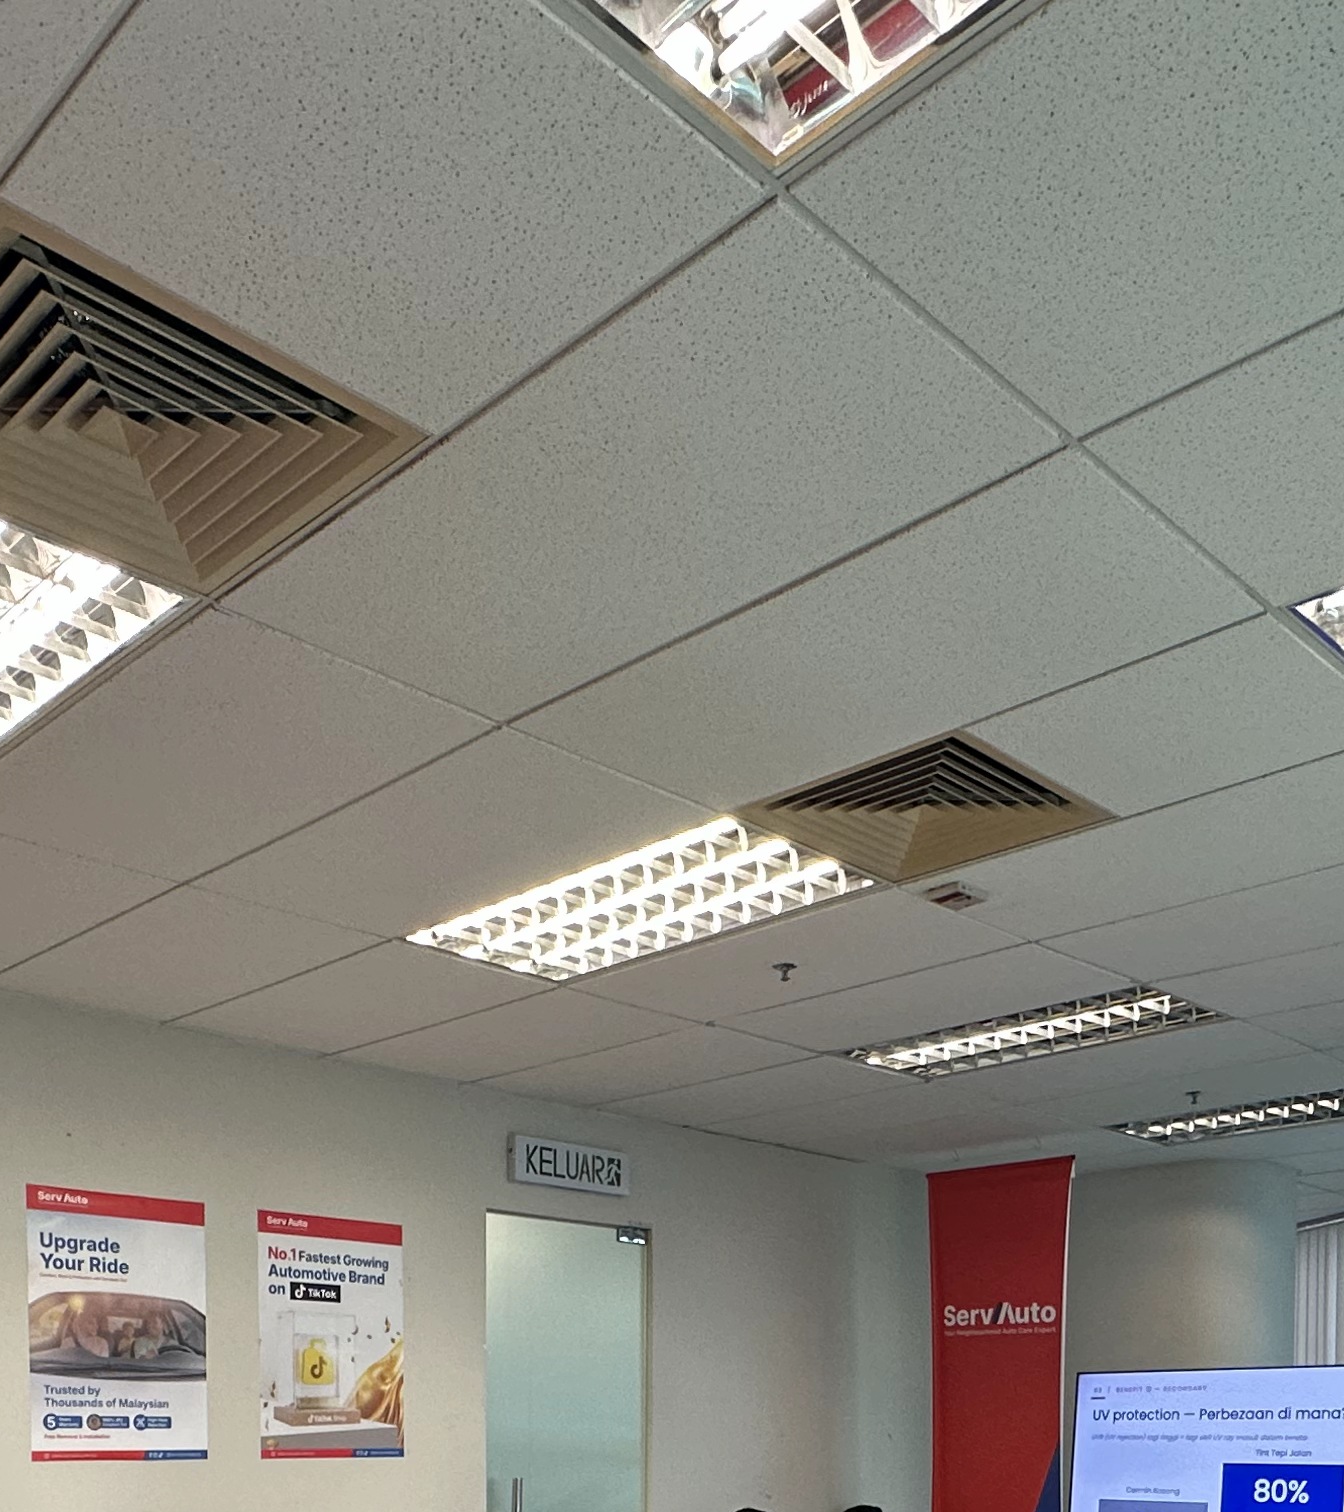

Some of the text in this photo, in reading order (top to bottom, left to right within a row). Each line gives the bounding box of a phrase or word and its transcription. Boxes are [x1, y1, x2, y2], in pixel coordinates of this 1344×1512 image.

[526, 1144, 605, 1184] KELUAR
[39, 1231, 121, 1254] Upgrade
[40, 1253, 129, 1275] Your Ride
[268, 1246, 389, 1272] No.1 Fastest Growing
[269, 1264, 385, 1285] Automotive Brand
[268, 1284, 337, 1300] on TikTok
[44, 1385, 101, 1397] Trusted by
[44, 1398, 169, 1411] Thousands of Malaysian
[47, 1416, 56, 1428] 5
[1093, 1409, 1110, 1421] UV
[1113, 1408, 1180, 1424] protection
[1199, 1407, 1274, 1420] Perbezaan
[1278, 1407, 1291, 1420] di
[1253, 1479, 1309, 1504] 80%
